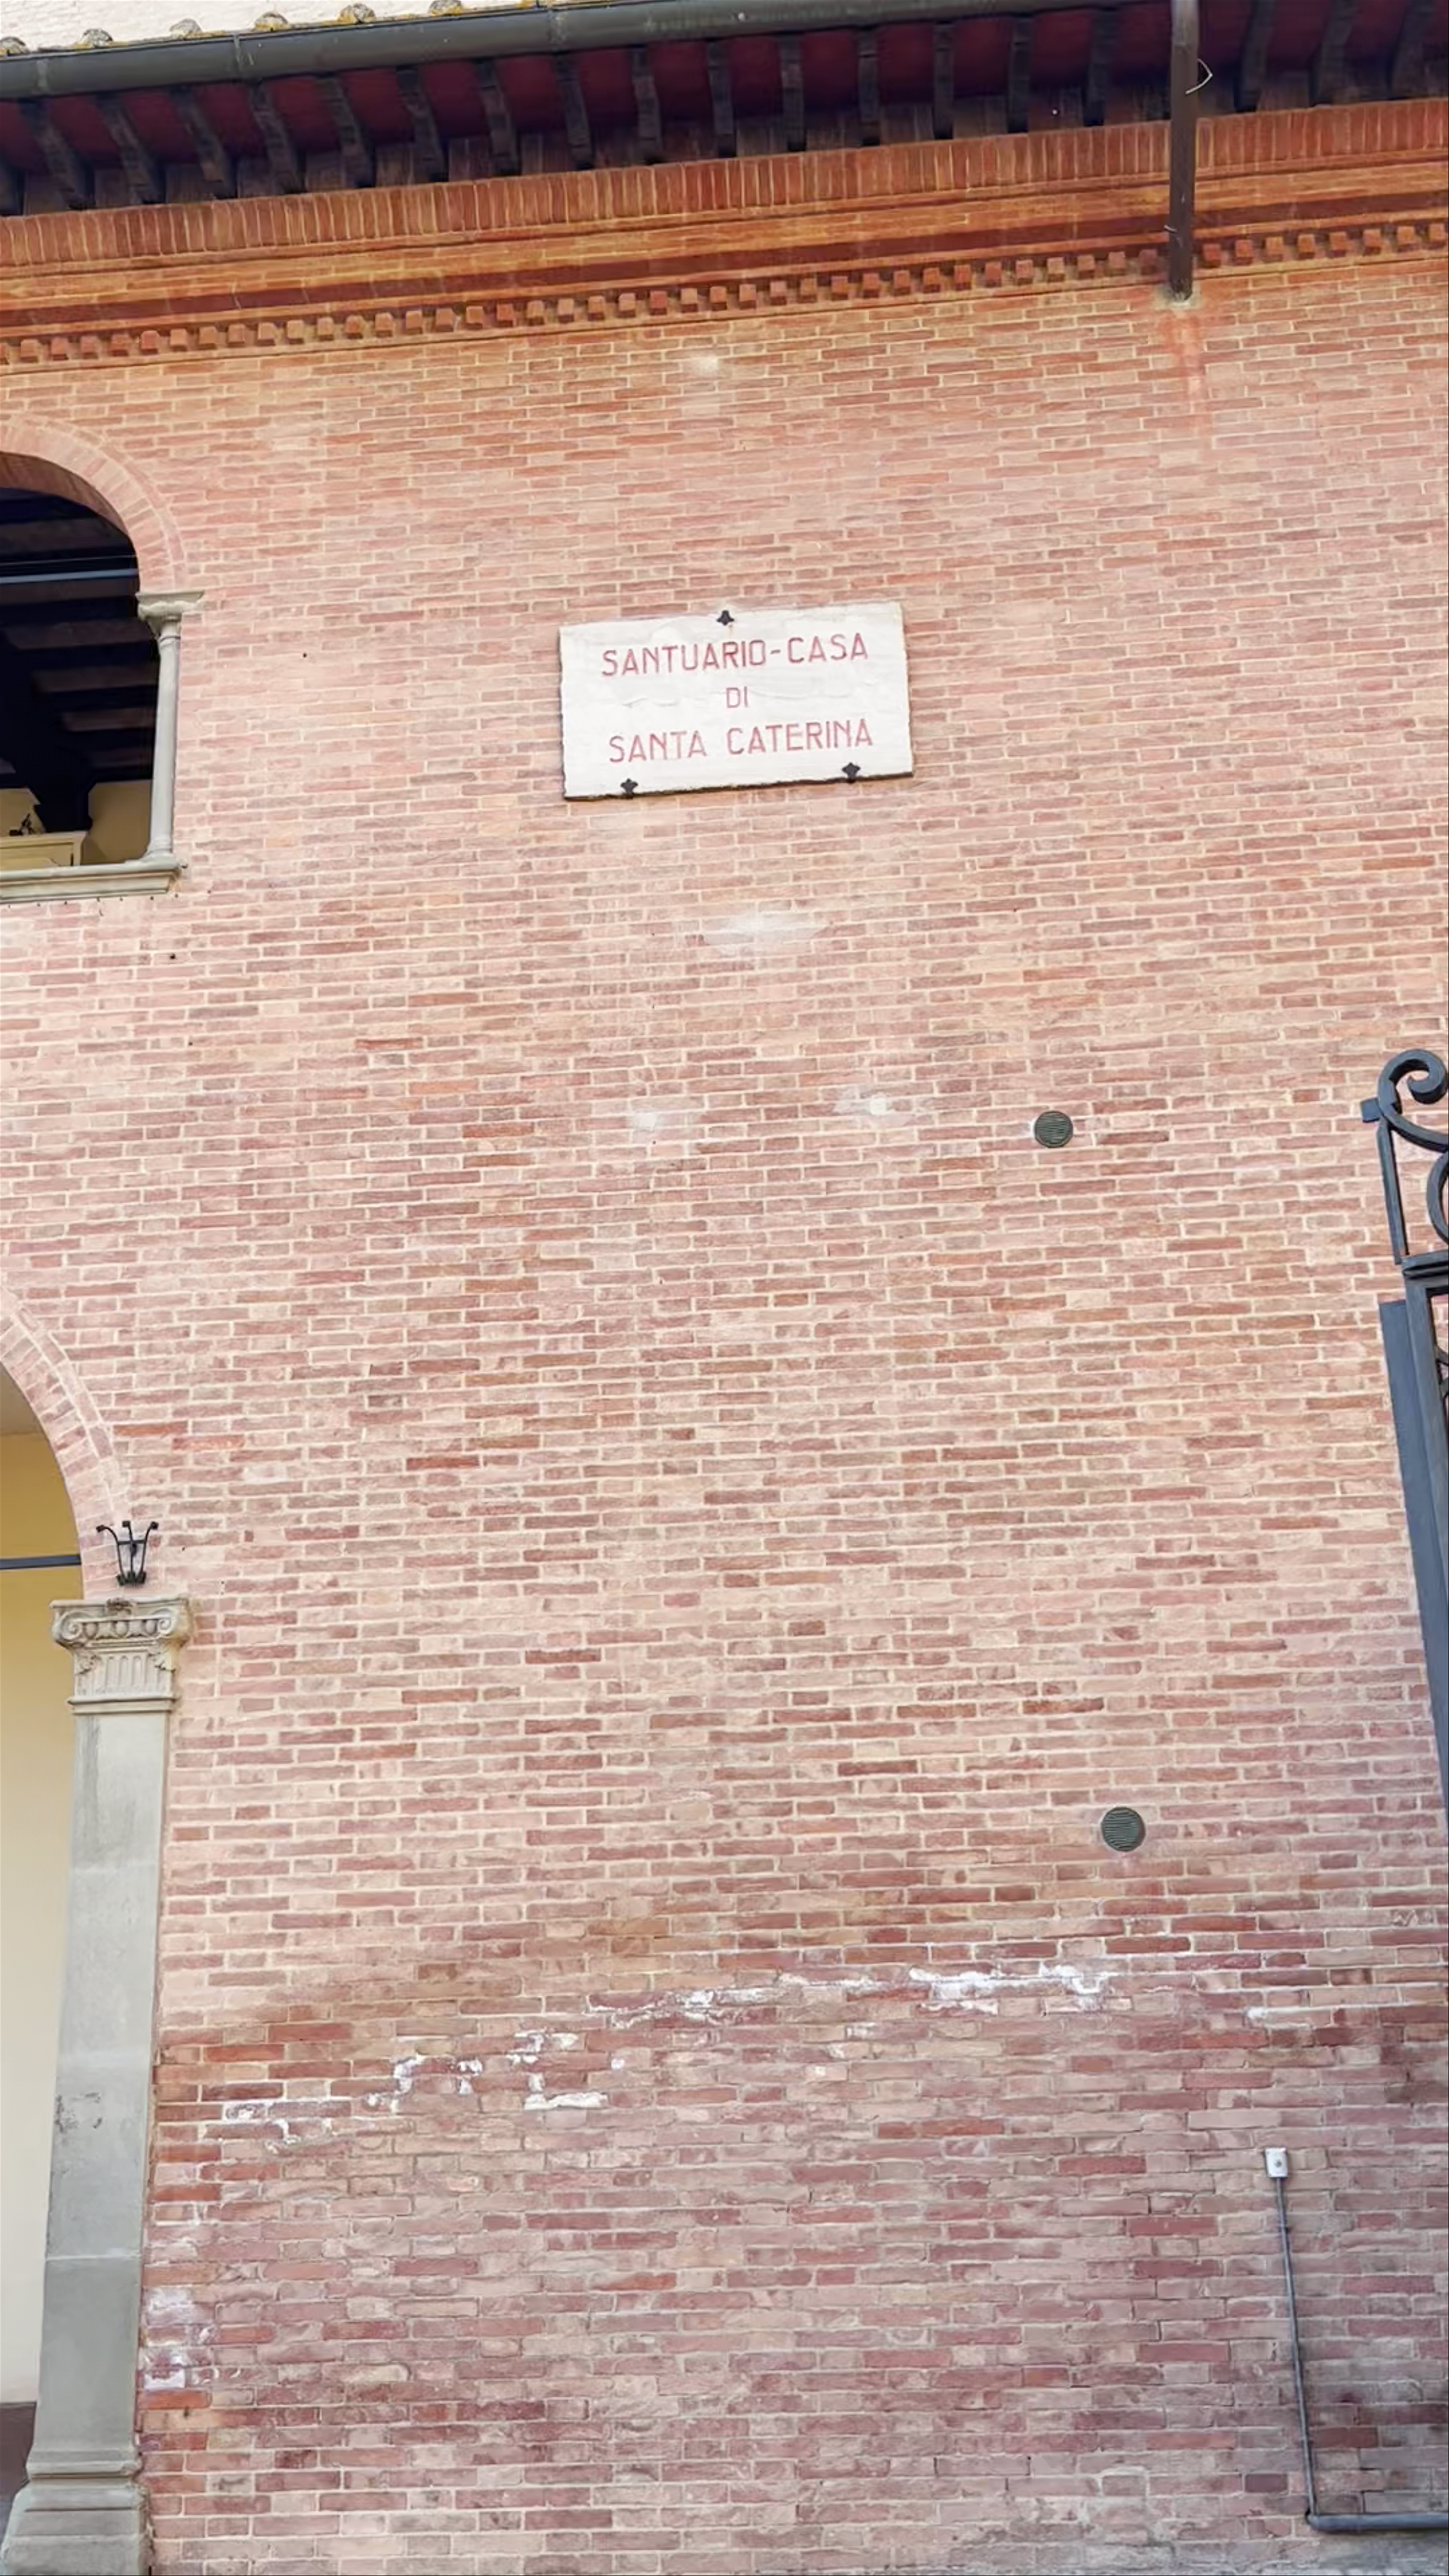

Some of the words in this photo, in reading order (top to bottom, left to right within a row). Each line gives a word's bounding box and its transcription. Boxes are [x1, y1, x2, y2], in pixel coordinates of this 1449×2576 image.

[602, 633, 868, 677] SANTUARIO-CASA
[726, 686, 748, 709] DI
[609, 731, 707, 763] SANTA
[727, 719, 873, 755] CATERINA
